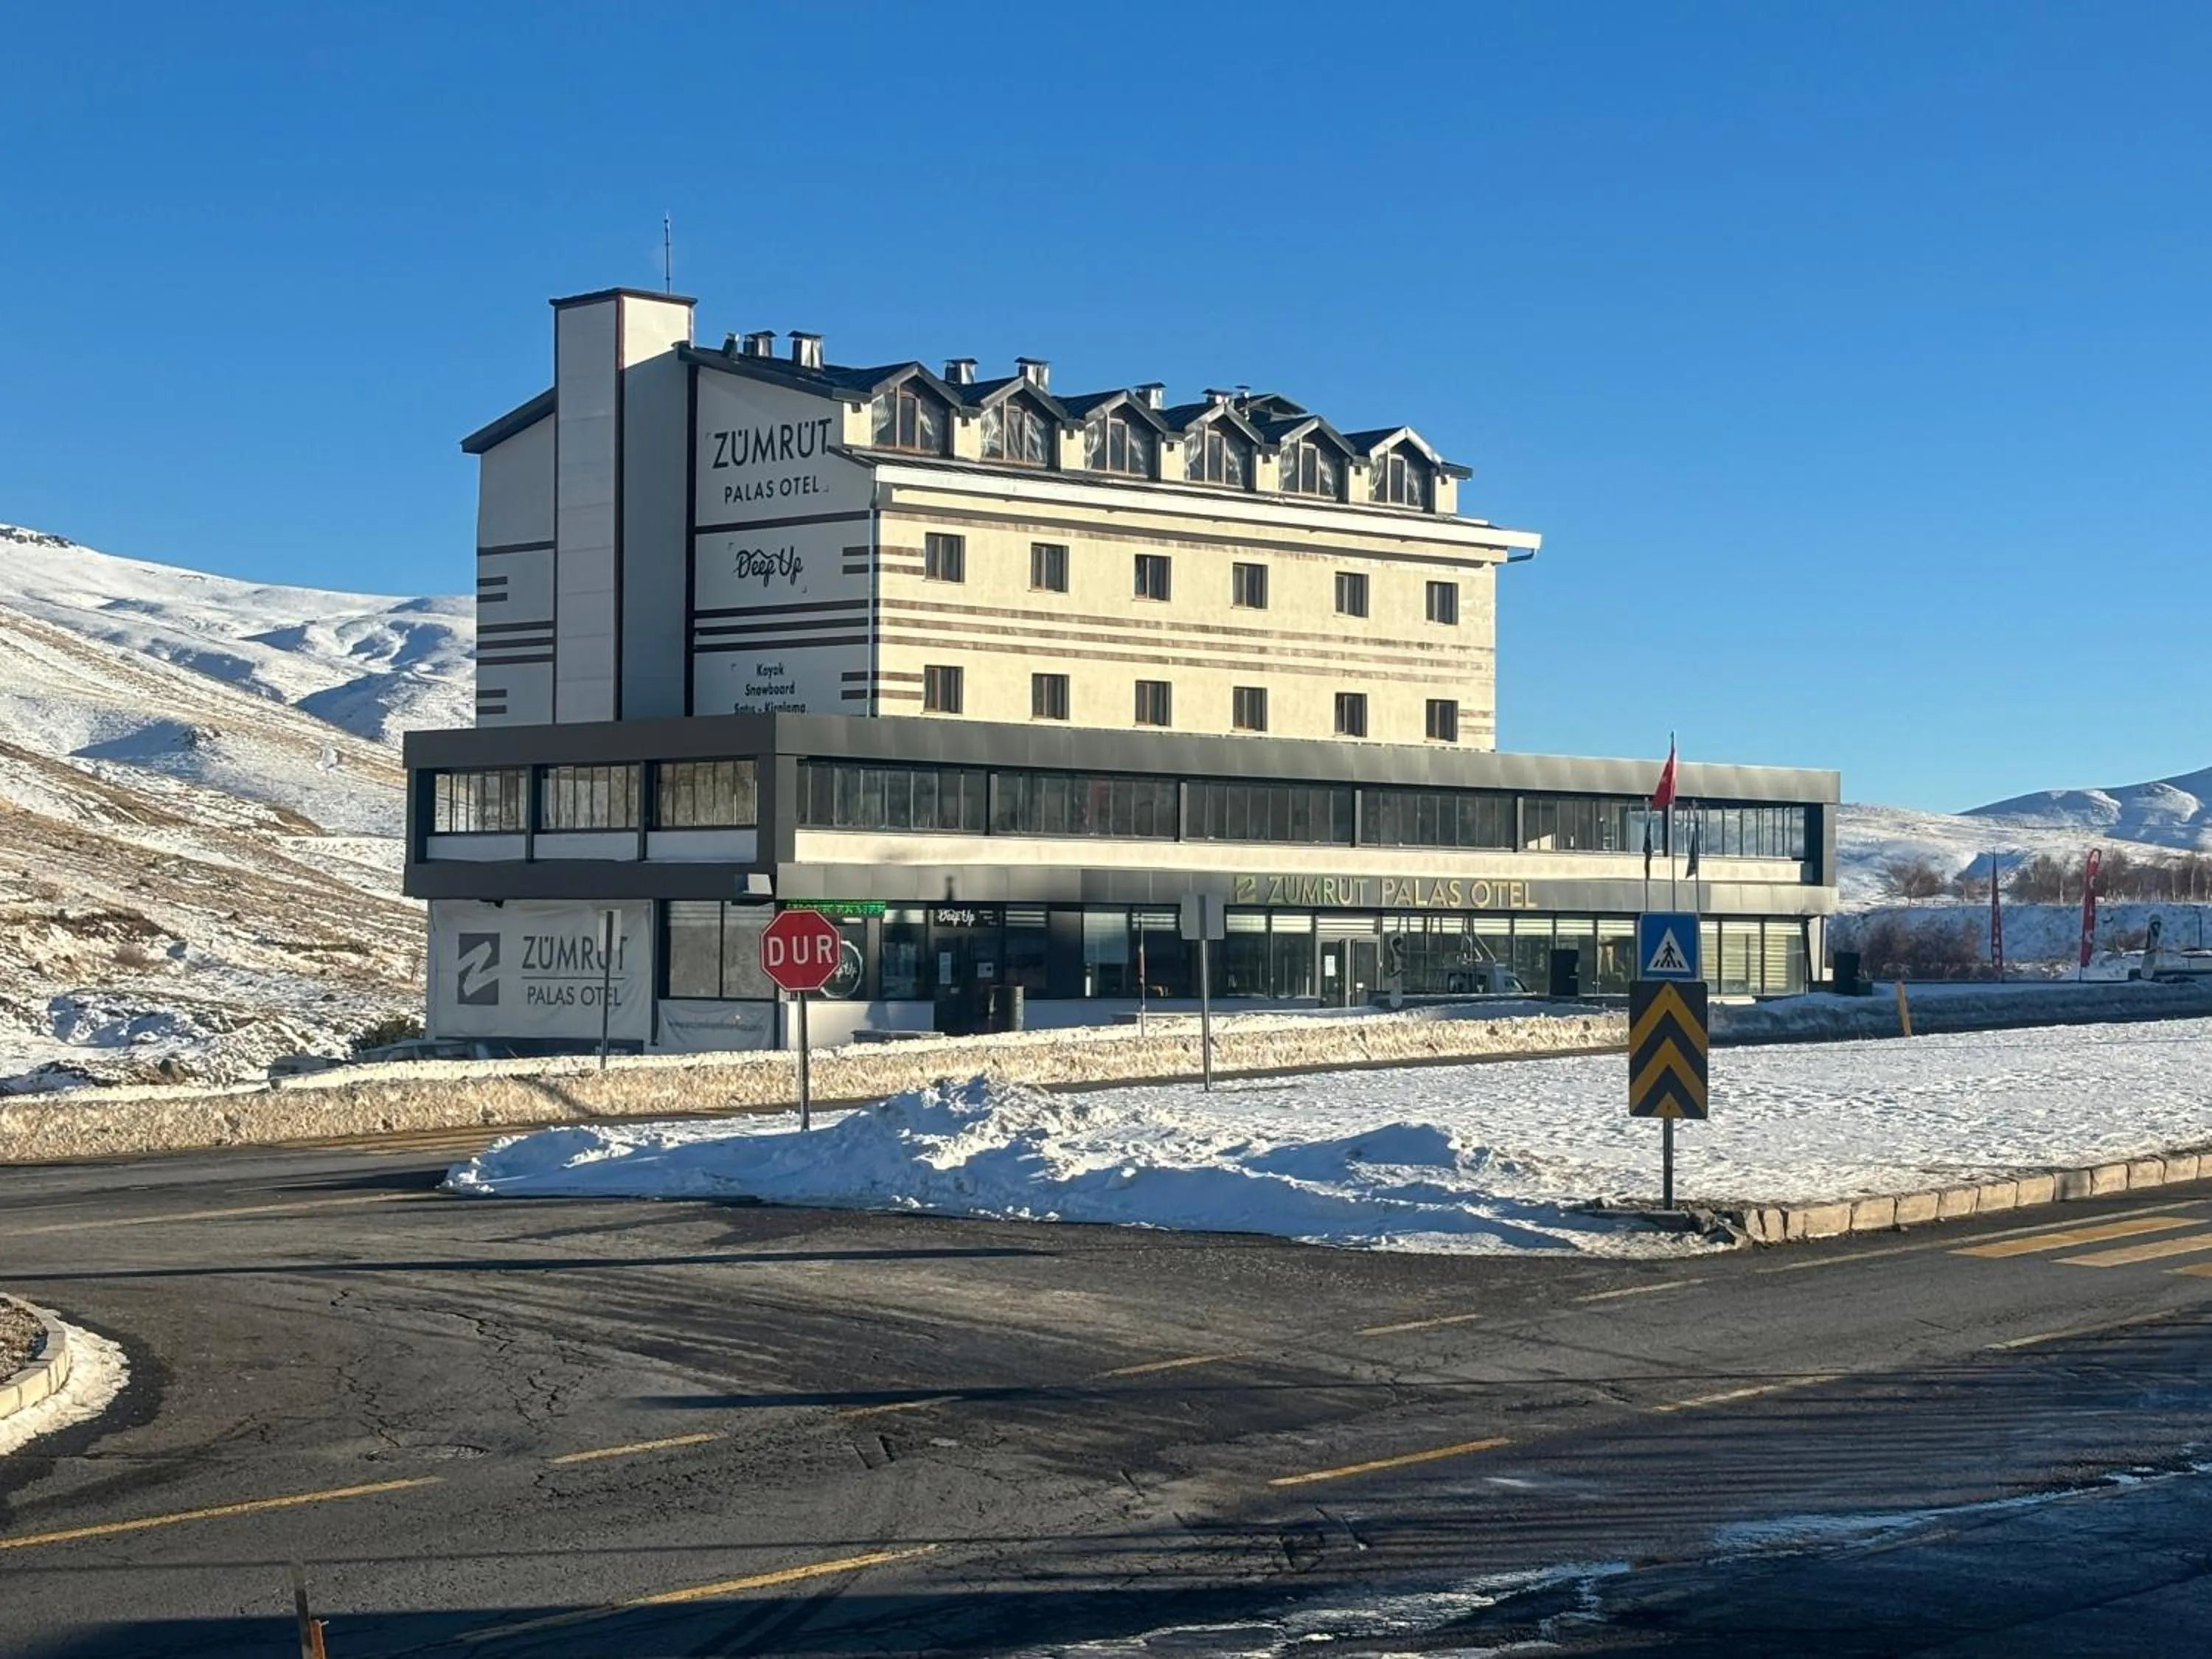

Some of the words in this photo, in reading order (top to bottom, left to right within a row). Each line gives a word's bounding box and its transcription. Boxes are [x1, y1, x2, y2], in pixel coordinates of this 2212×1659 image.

[712, 418, 832, 469] ZÜMRÜT
[725, 480, 774, 504] PALAS
[779, 475, 819, 496] OTEL
[734, 549, 776, 588] Deep
[779, 546, 804, 585] Up
[757, 662, 785, 679] Kayak
[745, 680, 796, 696] Snowboard
[1380, 877, 1463, 908] PALAS
[1470, 880, 1538, 908] OTEL
[768, 934, 834, 967] DUR
[526, 985, 575, 1006] PALAS
